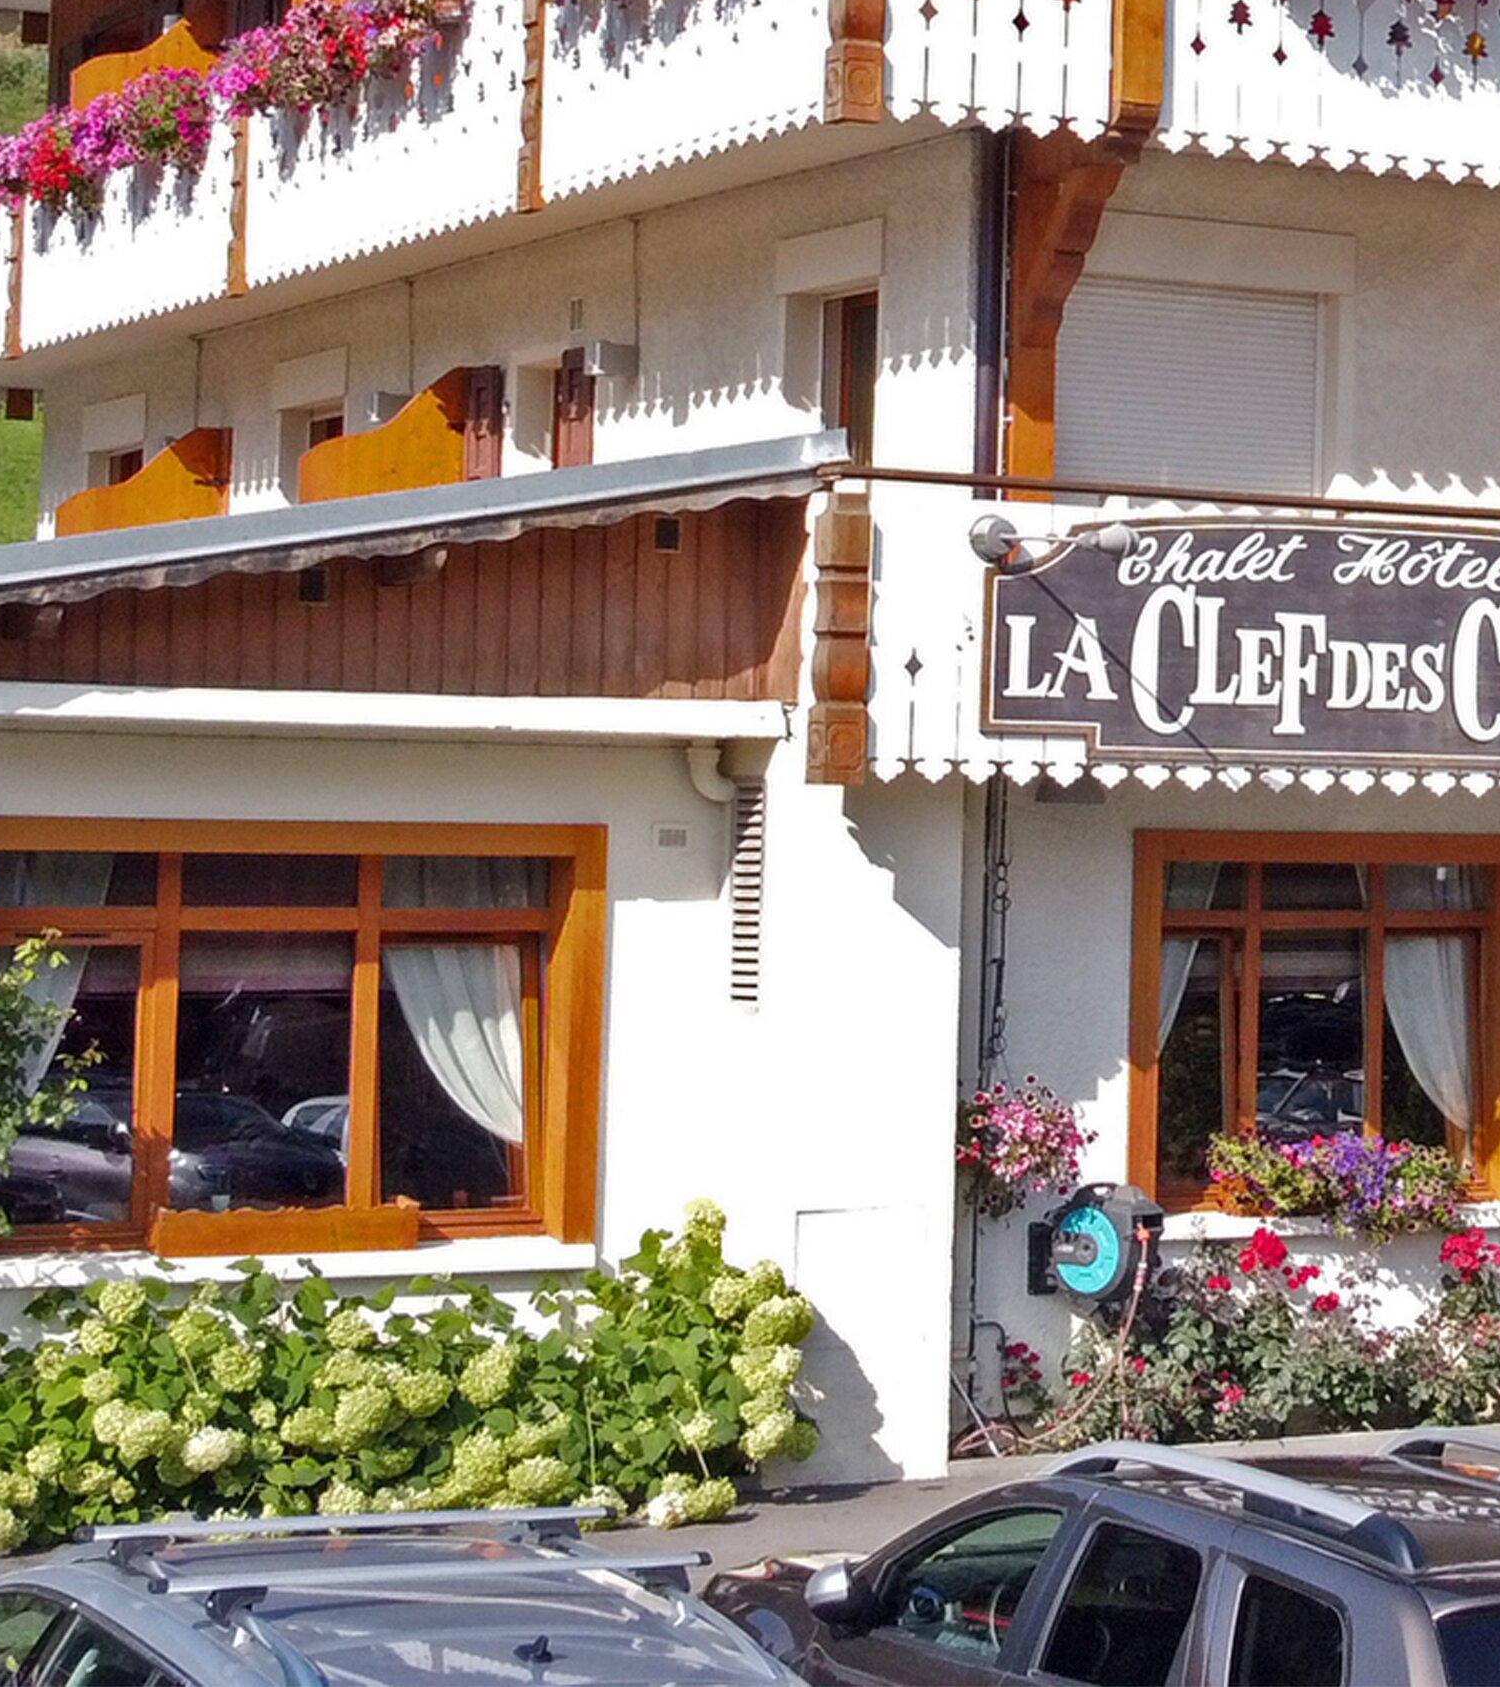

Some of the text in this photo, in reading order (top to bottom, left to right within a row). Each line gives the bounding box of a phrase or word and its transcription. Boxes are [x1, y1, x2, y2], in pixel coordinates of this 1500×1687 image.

[1117, 531, 1307, 586] Chalet
[1003, 613, 1118, 700] LA
[1326, 639, 1446, 713] DES
